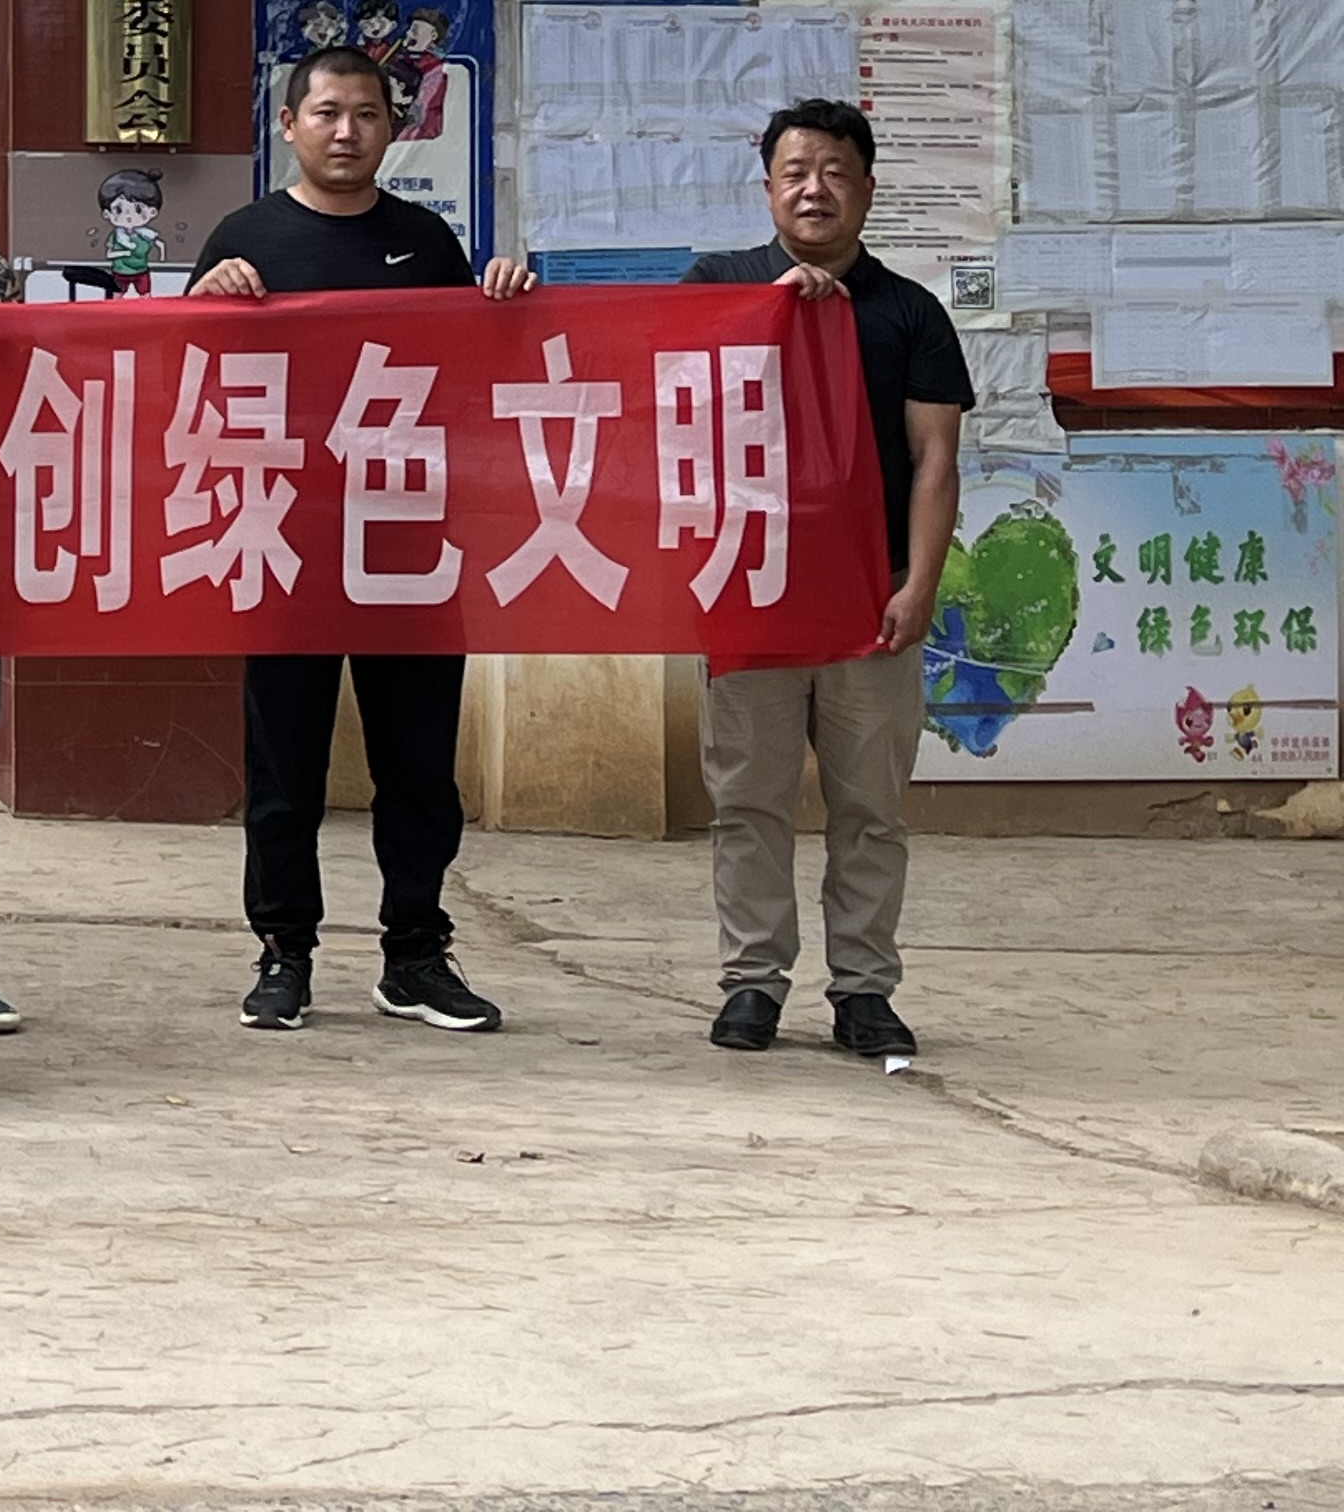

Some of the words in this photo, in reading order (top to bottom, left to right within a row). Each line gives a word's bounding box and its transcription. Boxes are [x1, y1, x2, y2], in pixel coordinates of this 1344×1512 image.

[1091, 530, 1269, 586] 文明健康
[1136, 604, 1318, 657] 绿色环保
